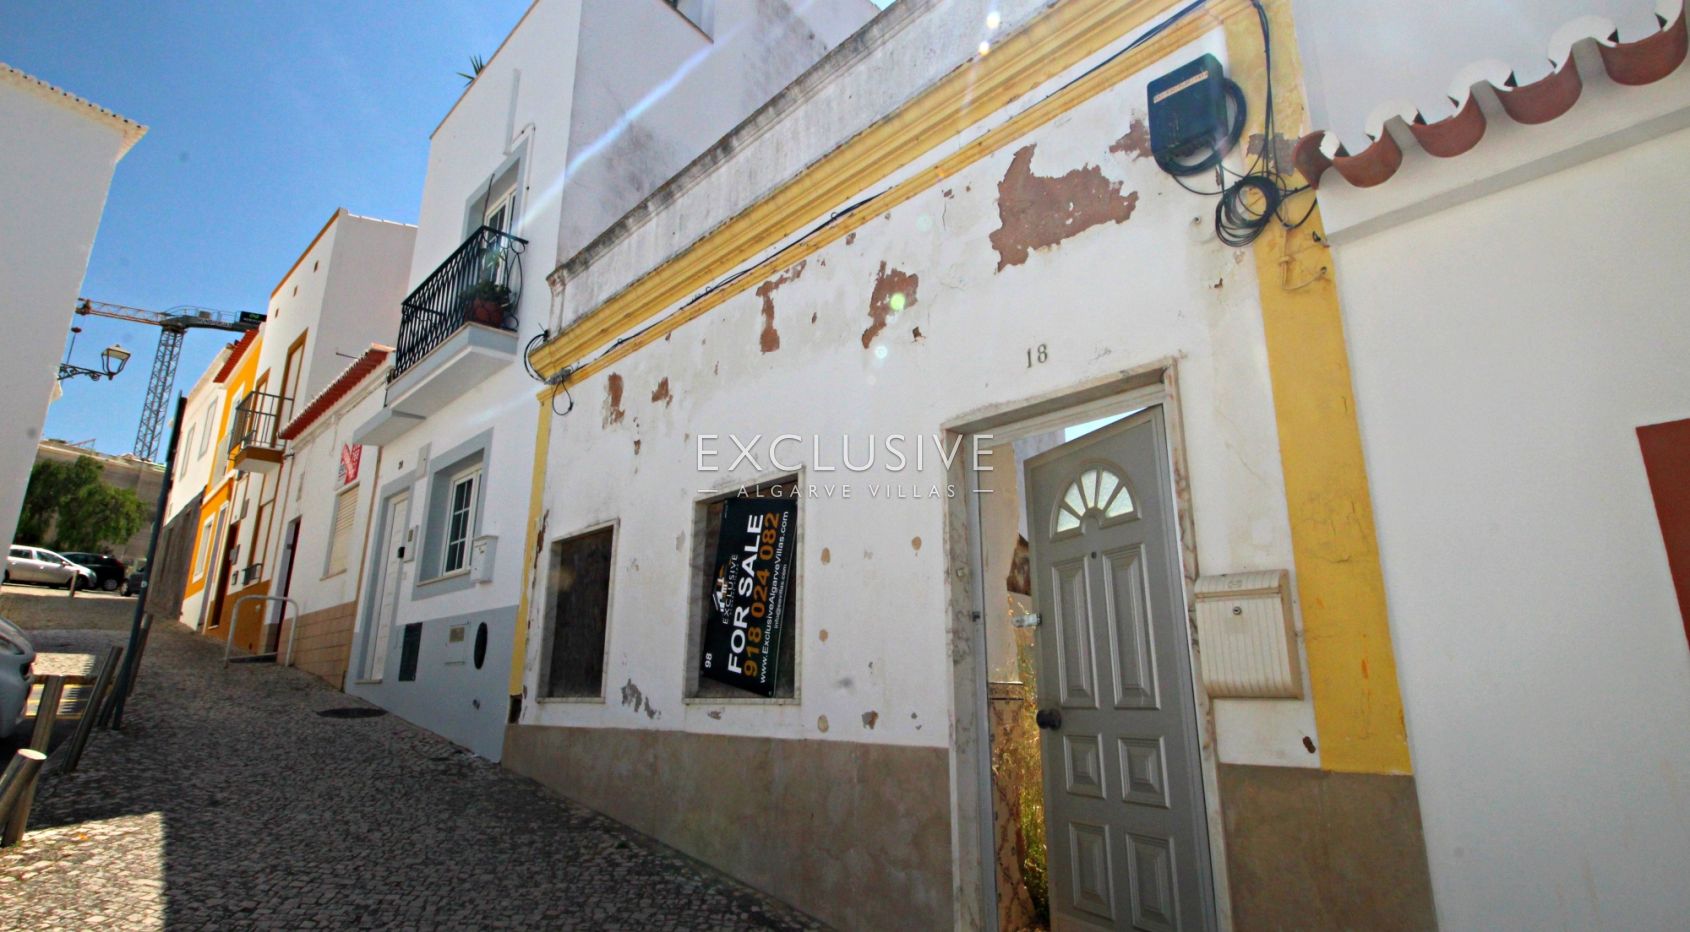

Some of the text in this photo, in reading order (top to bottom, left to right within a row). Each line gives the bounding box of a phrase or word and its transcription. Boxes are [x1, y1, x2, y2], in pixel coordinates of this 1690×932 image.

[1027, 343, 1048, 368] 18
[723, 554, 738, 625] EXCLUSIVE
[728, 514, 764, 674] FOR SALE
[744, 512, 780, 677] 918 024 082
[760, 511, 789, 684] www.ExclusiveAlgarveVillas.com
[705, 653, 713, 668] 98
